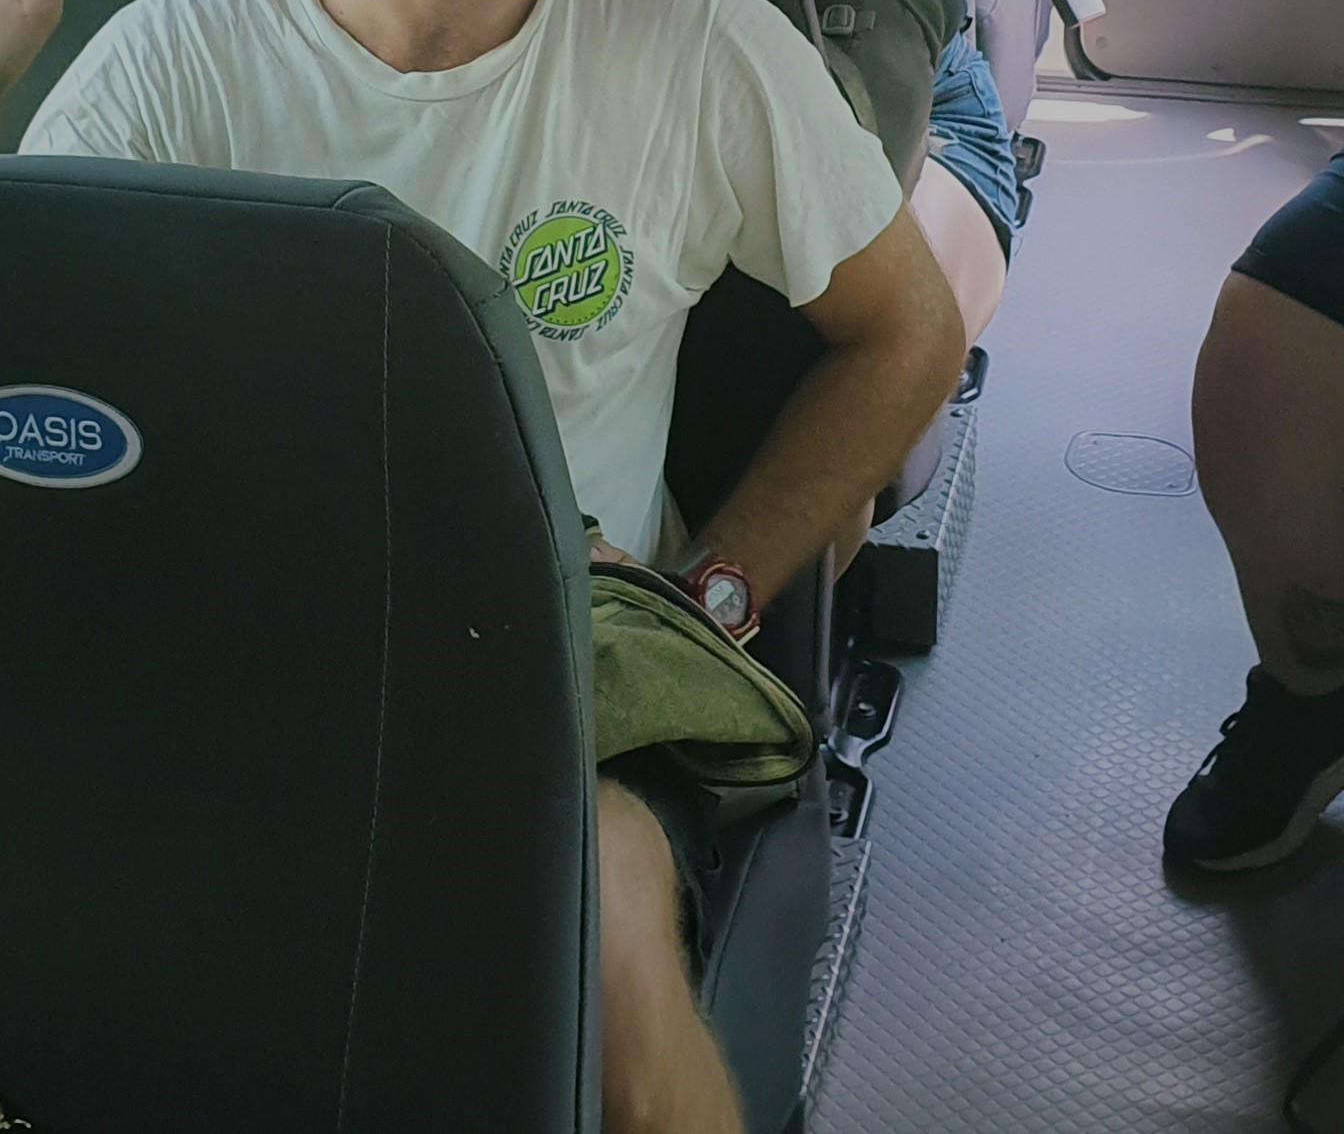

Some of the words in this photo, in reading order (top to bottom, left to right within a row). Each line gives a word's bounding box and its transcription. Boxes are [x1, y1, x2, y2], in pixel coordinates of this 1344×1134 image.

[499, 246, 514, 277] NTA
[510, 209, 539, 247] CRUZ
[545, 200, 595, 217] SANTA
[592, 208, 627, 238] CRUZ
[512, 222, 608, 287] SANTA
[620, 245, 634, 296] SANTA
[532, 259, 608, 318] CRUZ
[5, 446, 86, 466] TRANSPORT
